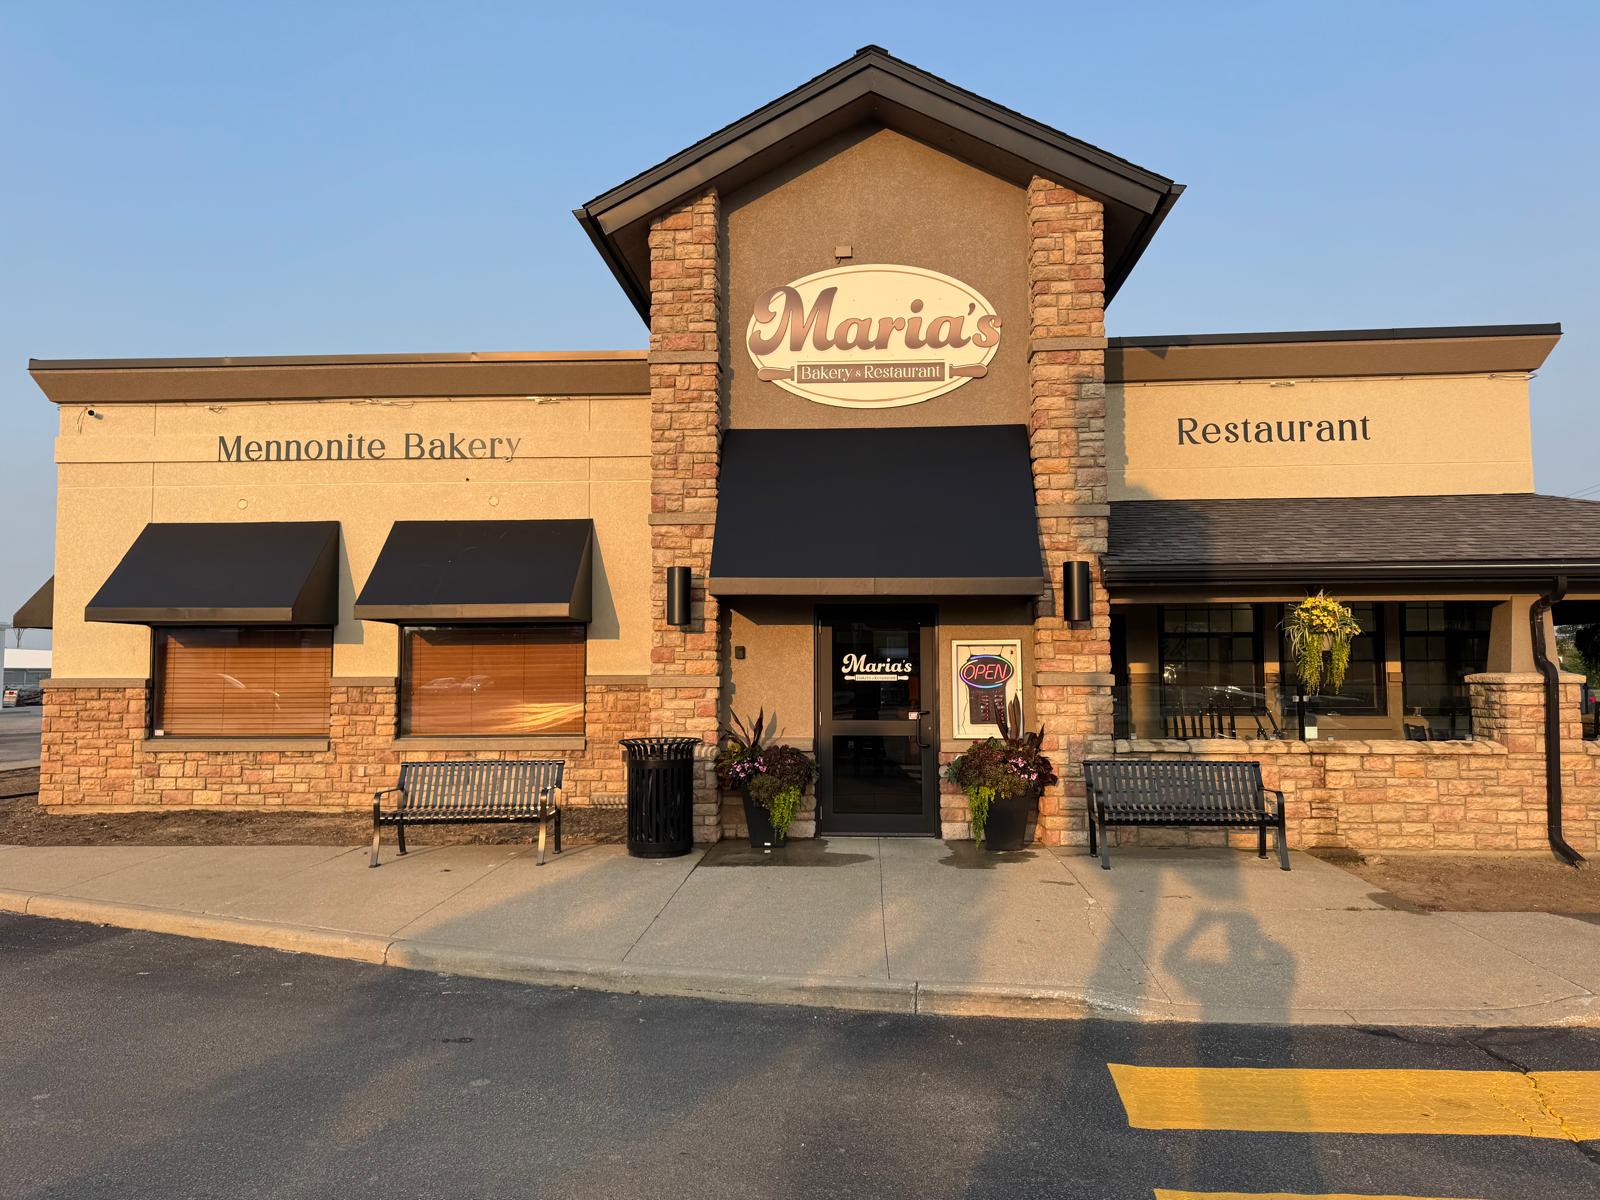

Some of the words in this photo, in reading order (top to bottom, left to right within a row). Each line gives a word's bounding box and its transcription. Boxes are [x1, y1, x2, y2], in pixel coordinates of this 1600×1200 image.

[749, 285, 1002, 356] Maria's
[801, 366, 852, 381] Bakery
[864, 364, 940, 379] Restaurant
[1177, 416, 1371, 446] Restaurant
[217, 433, 386, 462] Mennonite
[404, 432, 522, 462] Bakery
[841, 653, 912, 673] Maria's
[963, 664, 1008, 680] OPEN
